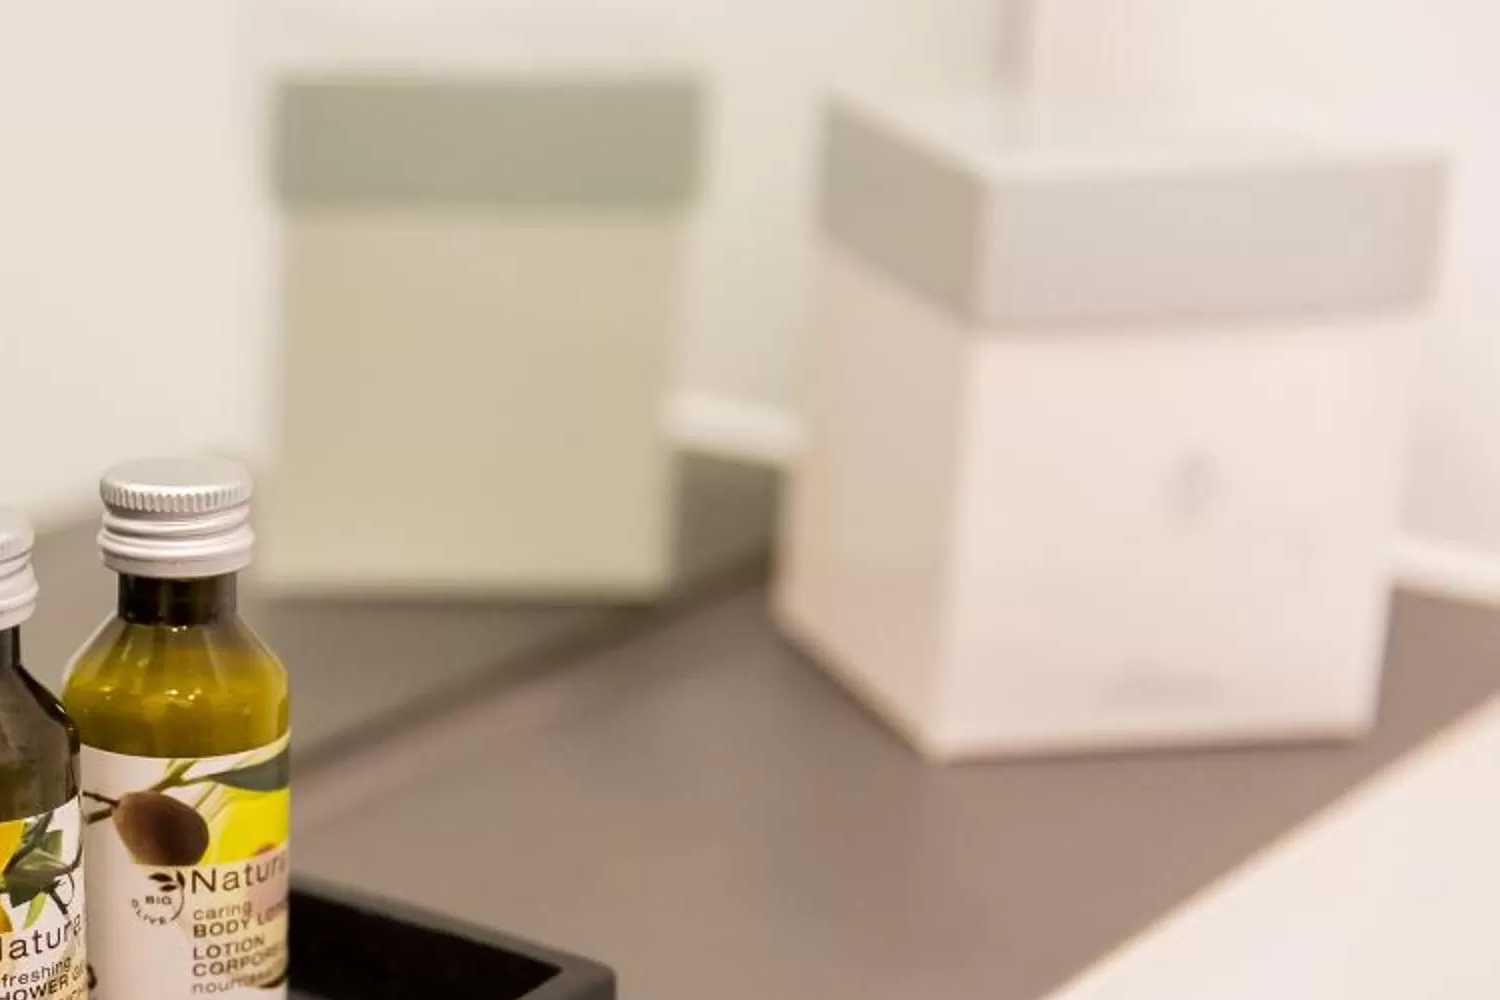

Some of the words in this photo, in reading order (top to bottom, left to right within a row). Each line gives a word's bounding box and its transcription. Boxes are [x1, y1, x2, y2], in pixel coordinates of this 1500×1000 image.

[193, 901, 253, 921] caring
[193, 918, 250, 939] BODY
[193, 934, 265, 961] LOTION
